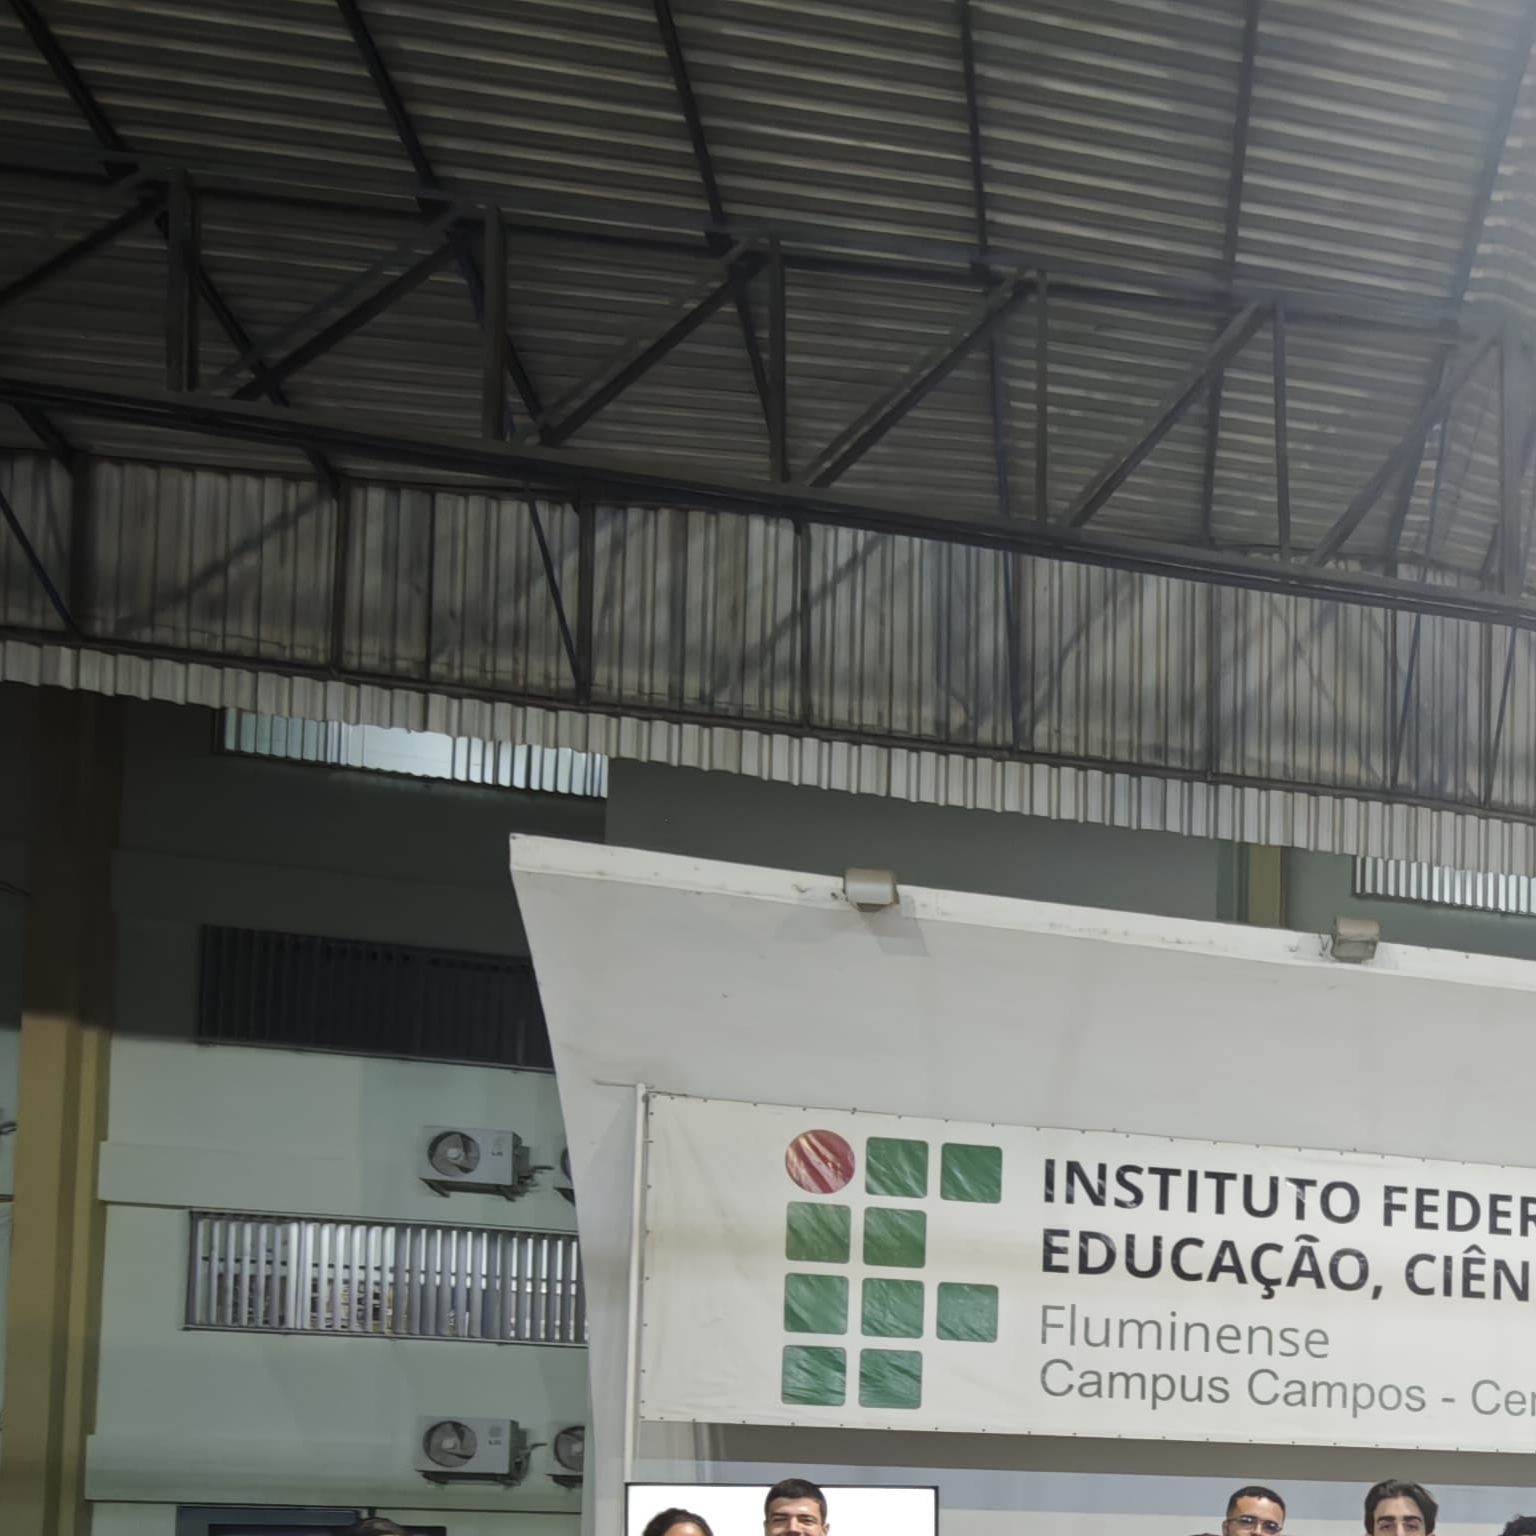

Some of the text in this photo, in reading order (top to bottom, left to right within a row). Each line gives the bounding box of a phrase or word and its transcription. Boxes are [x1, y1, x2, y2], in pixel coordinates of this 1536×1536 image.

[1044, 1158, 1361, 1225] INSTITUTO
[1042, 1228, 1383, 1301] EDUCAÇÃO,
[1041, 1303, 1330, 1358] Fluminense
[1040, 1358, 1230, 1410] Campus
[1248, 1368, 1427, 1419] Campos
